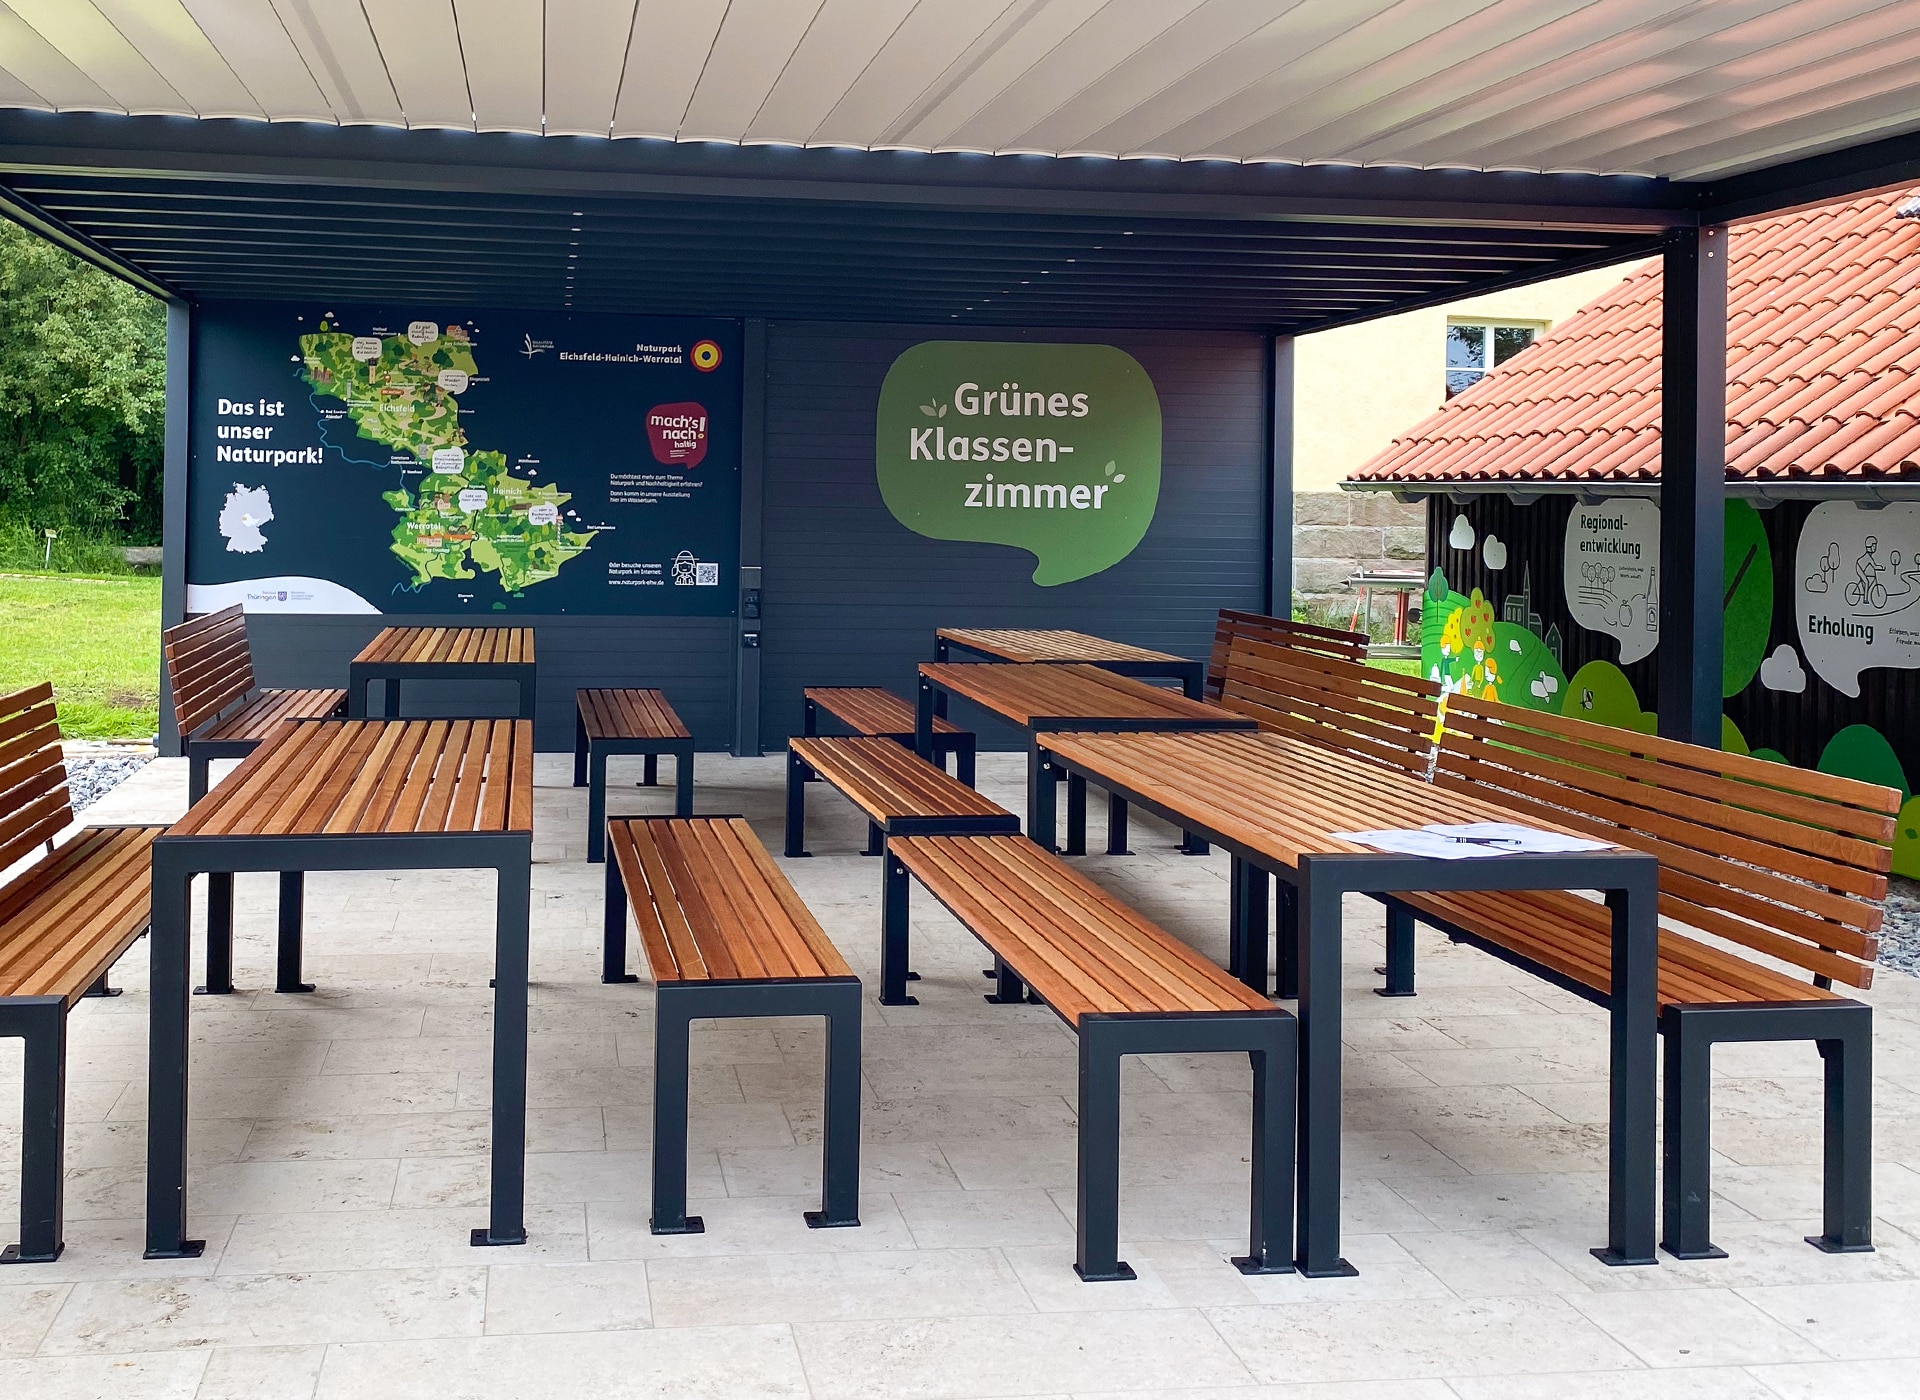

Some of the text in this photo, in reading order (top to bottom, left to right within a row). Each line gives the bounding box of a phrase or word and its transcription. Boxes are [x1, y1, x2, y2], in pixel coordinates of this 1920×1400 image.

[636, 343, 682, 354] Naturpark
[559, 351, 683, 364] Eichsfeld-Hainich-Werratal
[954, 382, 1090, 418] Grünes
[217, 398, 285, 417] Das ist
[380, 403, 416, 413] Eichsfeld
[217, 425, 274, 440] unser
[662, 427, 697, 440] nach
[674, 440, 697, 450] haltig
[910, 426, 1074, 463] Klassen-
[217, 445, 323, 467] Naturpark!
[493, 487, 522, 495] Hainich
[964, 473, 1109, 509] zimmer
[407, 522, 441, 530] Werratal
[1580, 514, 1629, 534] Regional-
[1580, 537, 1641, 560] entwicklung
[608, 568, 633, 576] Naturpark
[247, 593, 277, 601] Thüringen
[1808, 614, 1874, 645] Erholung
